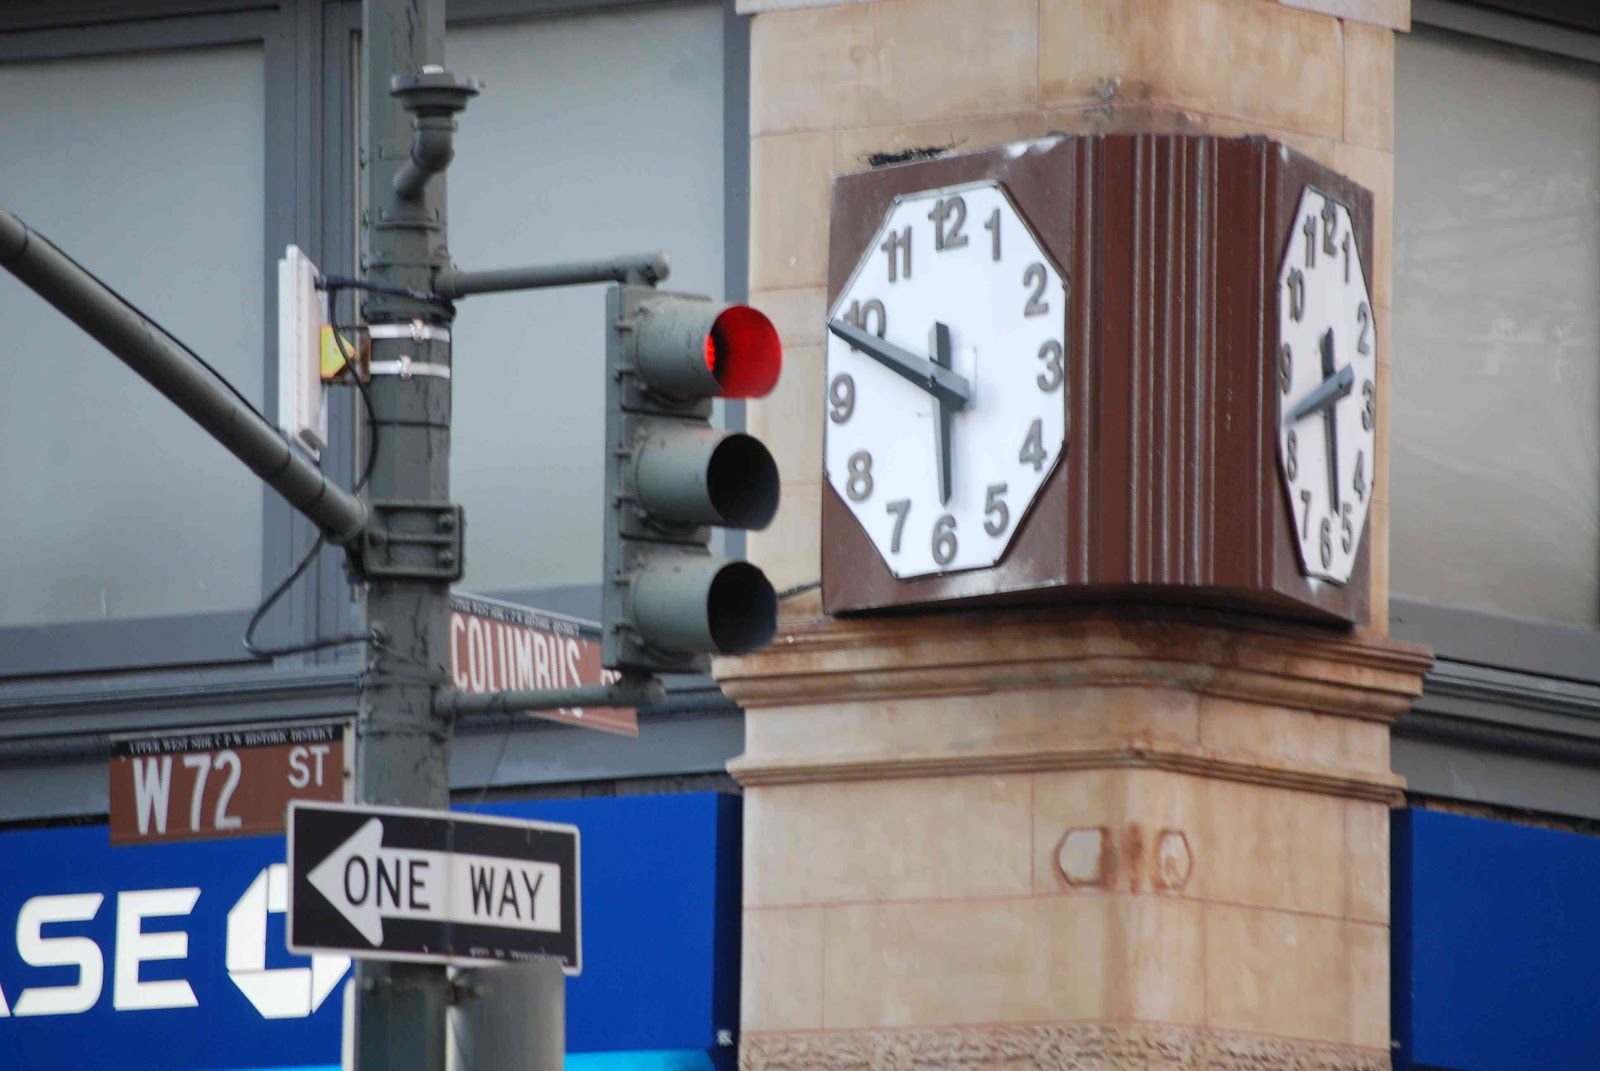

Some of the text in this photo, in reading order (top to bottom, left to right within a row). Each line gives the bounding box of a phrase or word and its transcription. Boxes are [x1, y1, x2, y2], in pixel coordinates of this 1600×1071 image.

[928, 196, 968, 253] 12
[984, 208, 1000, 262] 1
[1322, 198, 1337, 257] 12
[881, 224, 912, 283] 11
[1342, 231, 1350, 285] 1
[1023, 262, 1049, 319] 2
[1287, 267, 1305, 322] 10
[1357, 301, 1370, 357] 2
[1037, 339, 1064, 394] 3
[829, 373, 855, 425] 9
[1362, 378, 1376, 432] 3
[1019, 417, 1047, 472] 4
[1287, 429, 1298, 482] 8
[846, 449, 874, 502] 8
[886, 497, 912, 555] 7
[983, 483, 1009, 537] 5
[1301, 489, 1312, 540] 7
[1342, 502, 1353, 555] 5
[931, 514, 958, 566] 6
[1320, 516, 1332, 569] 6
[451, 612, 583, 718] COLUMBUS
[132, 745, 330, 836] W 72 ST
[344, 855, 544, 921] ONE WAY
[0, 887, 201, 1018] SE
